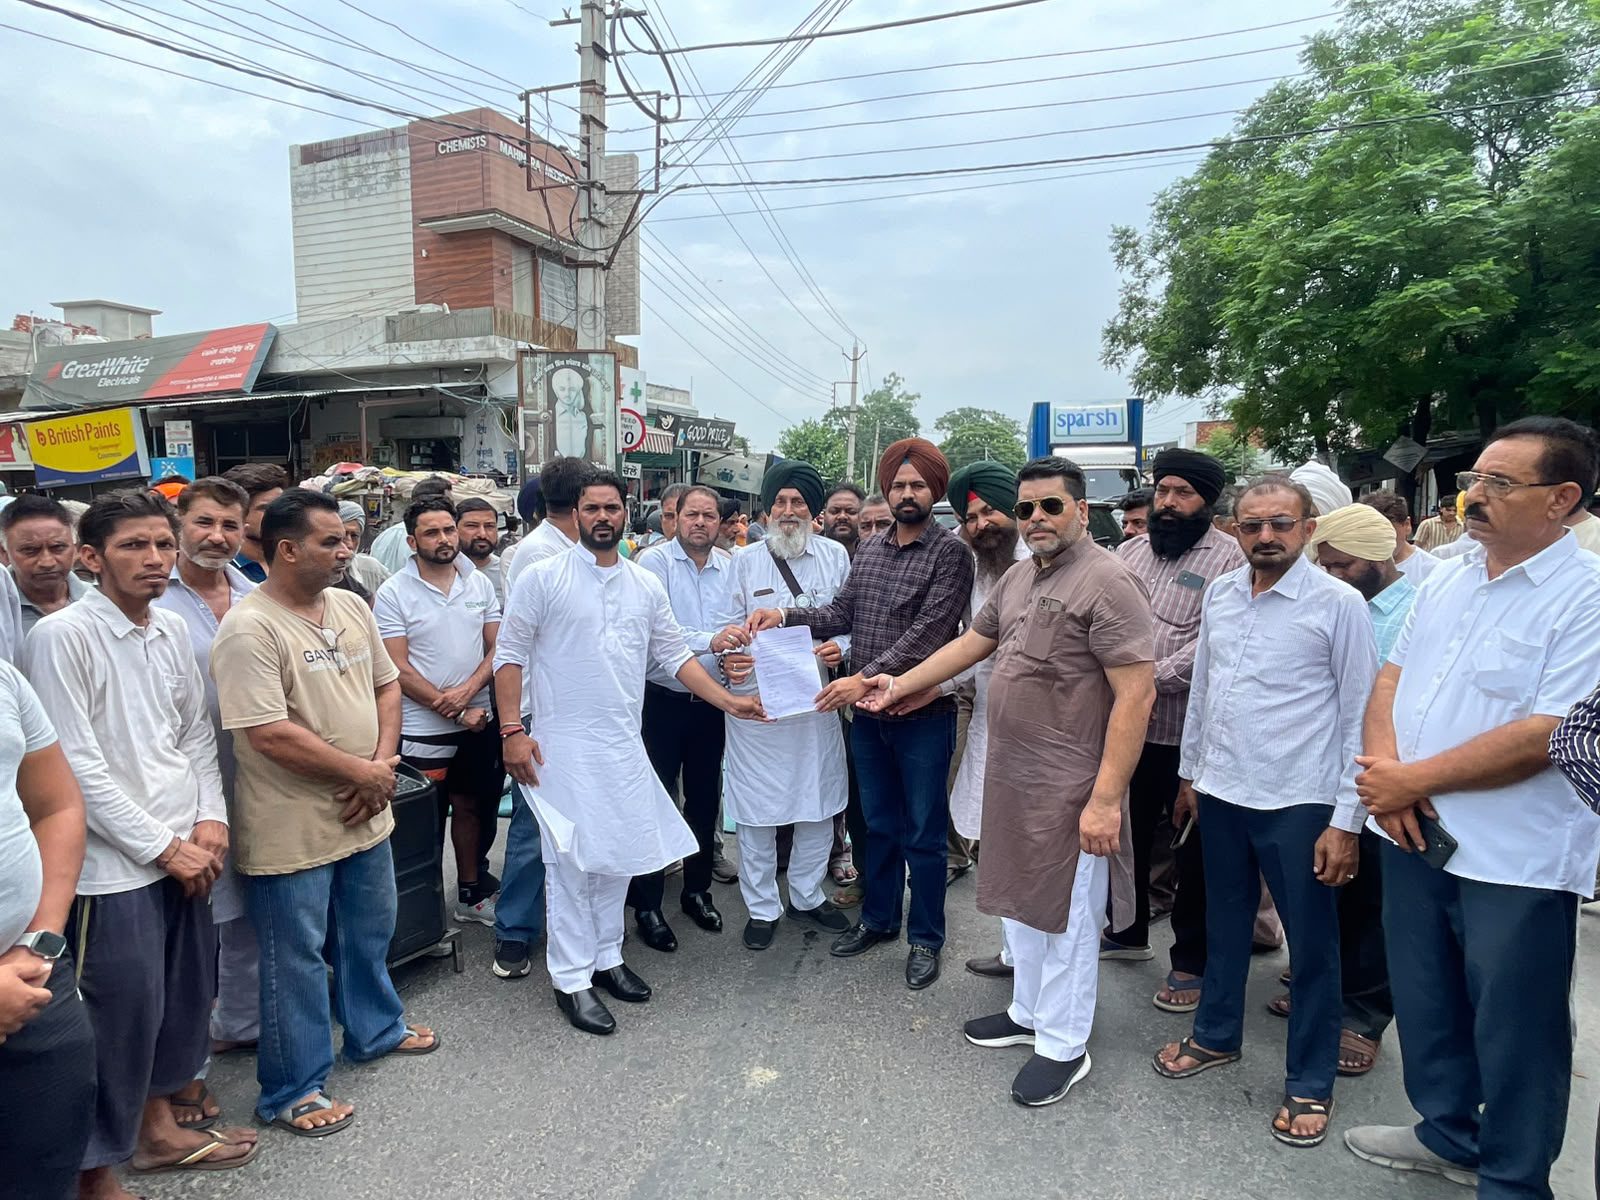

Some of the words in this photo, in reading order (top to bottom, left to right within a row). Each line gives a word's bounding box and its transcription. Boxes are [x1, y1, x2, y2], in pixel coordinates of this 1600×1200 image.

[438, 135, 487, 154] CHEMISTS
[500, 140, 541, 172] MAHINRA
[62, 355, 151, 379] GreatWhite
[97, 375, 141, 387] Electricals
[47, 424, 85, 446] British
[84, 420, 121, 441] Paints
[687, 425, 707, 441] GOOD
[707, 426, 727, 443] PRICE
[1057, 408, 1118, 435] sparsh
